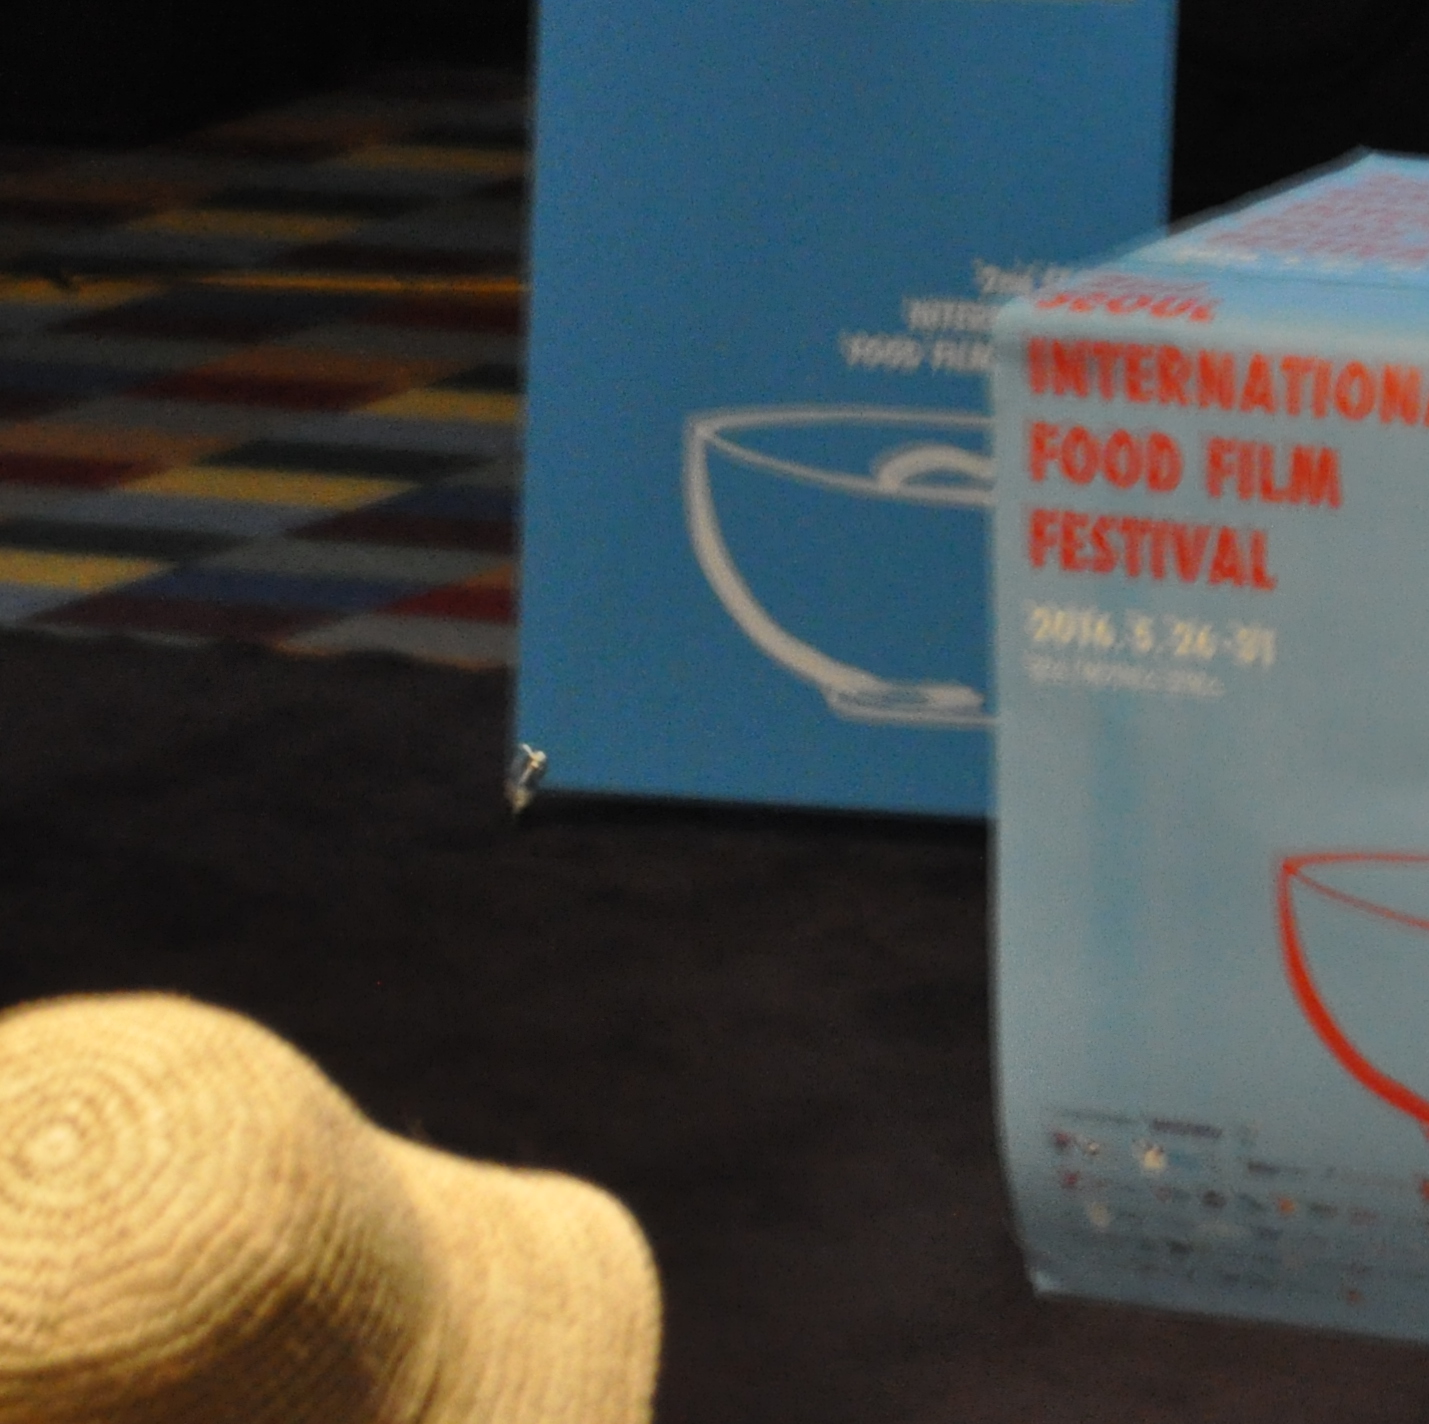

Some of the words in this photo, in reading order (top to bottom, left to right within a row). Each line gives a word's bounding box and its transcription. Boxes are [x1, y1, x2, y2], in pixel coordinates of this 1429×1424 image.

[1025, 419, 1186, 494] FOOD
[1204, 434, 1344, 509] FILM
[1025, 507, 1278, 592] FESTIVAL
